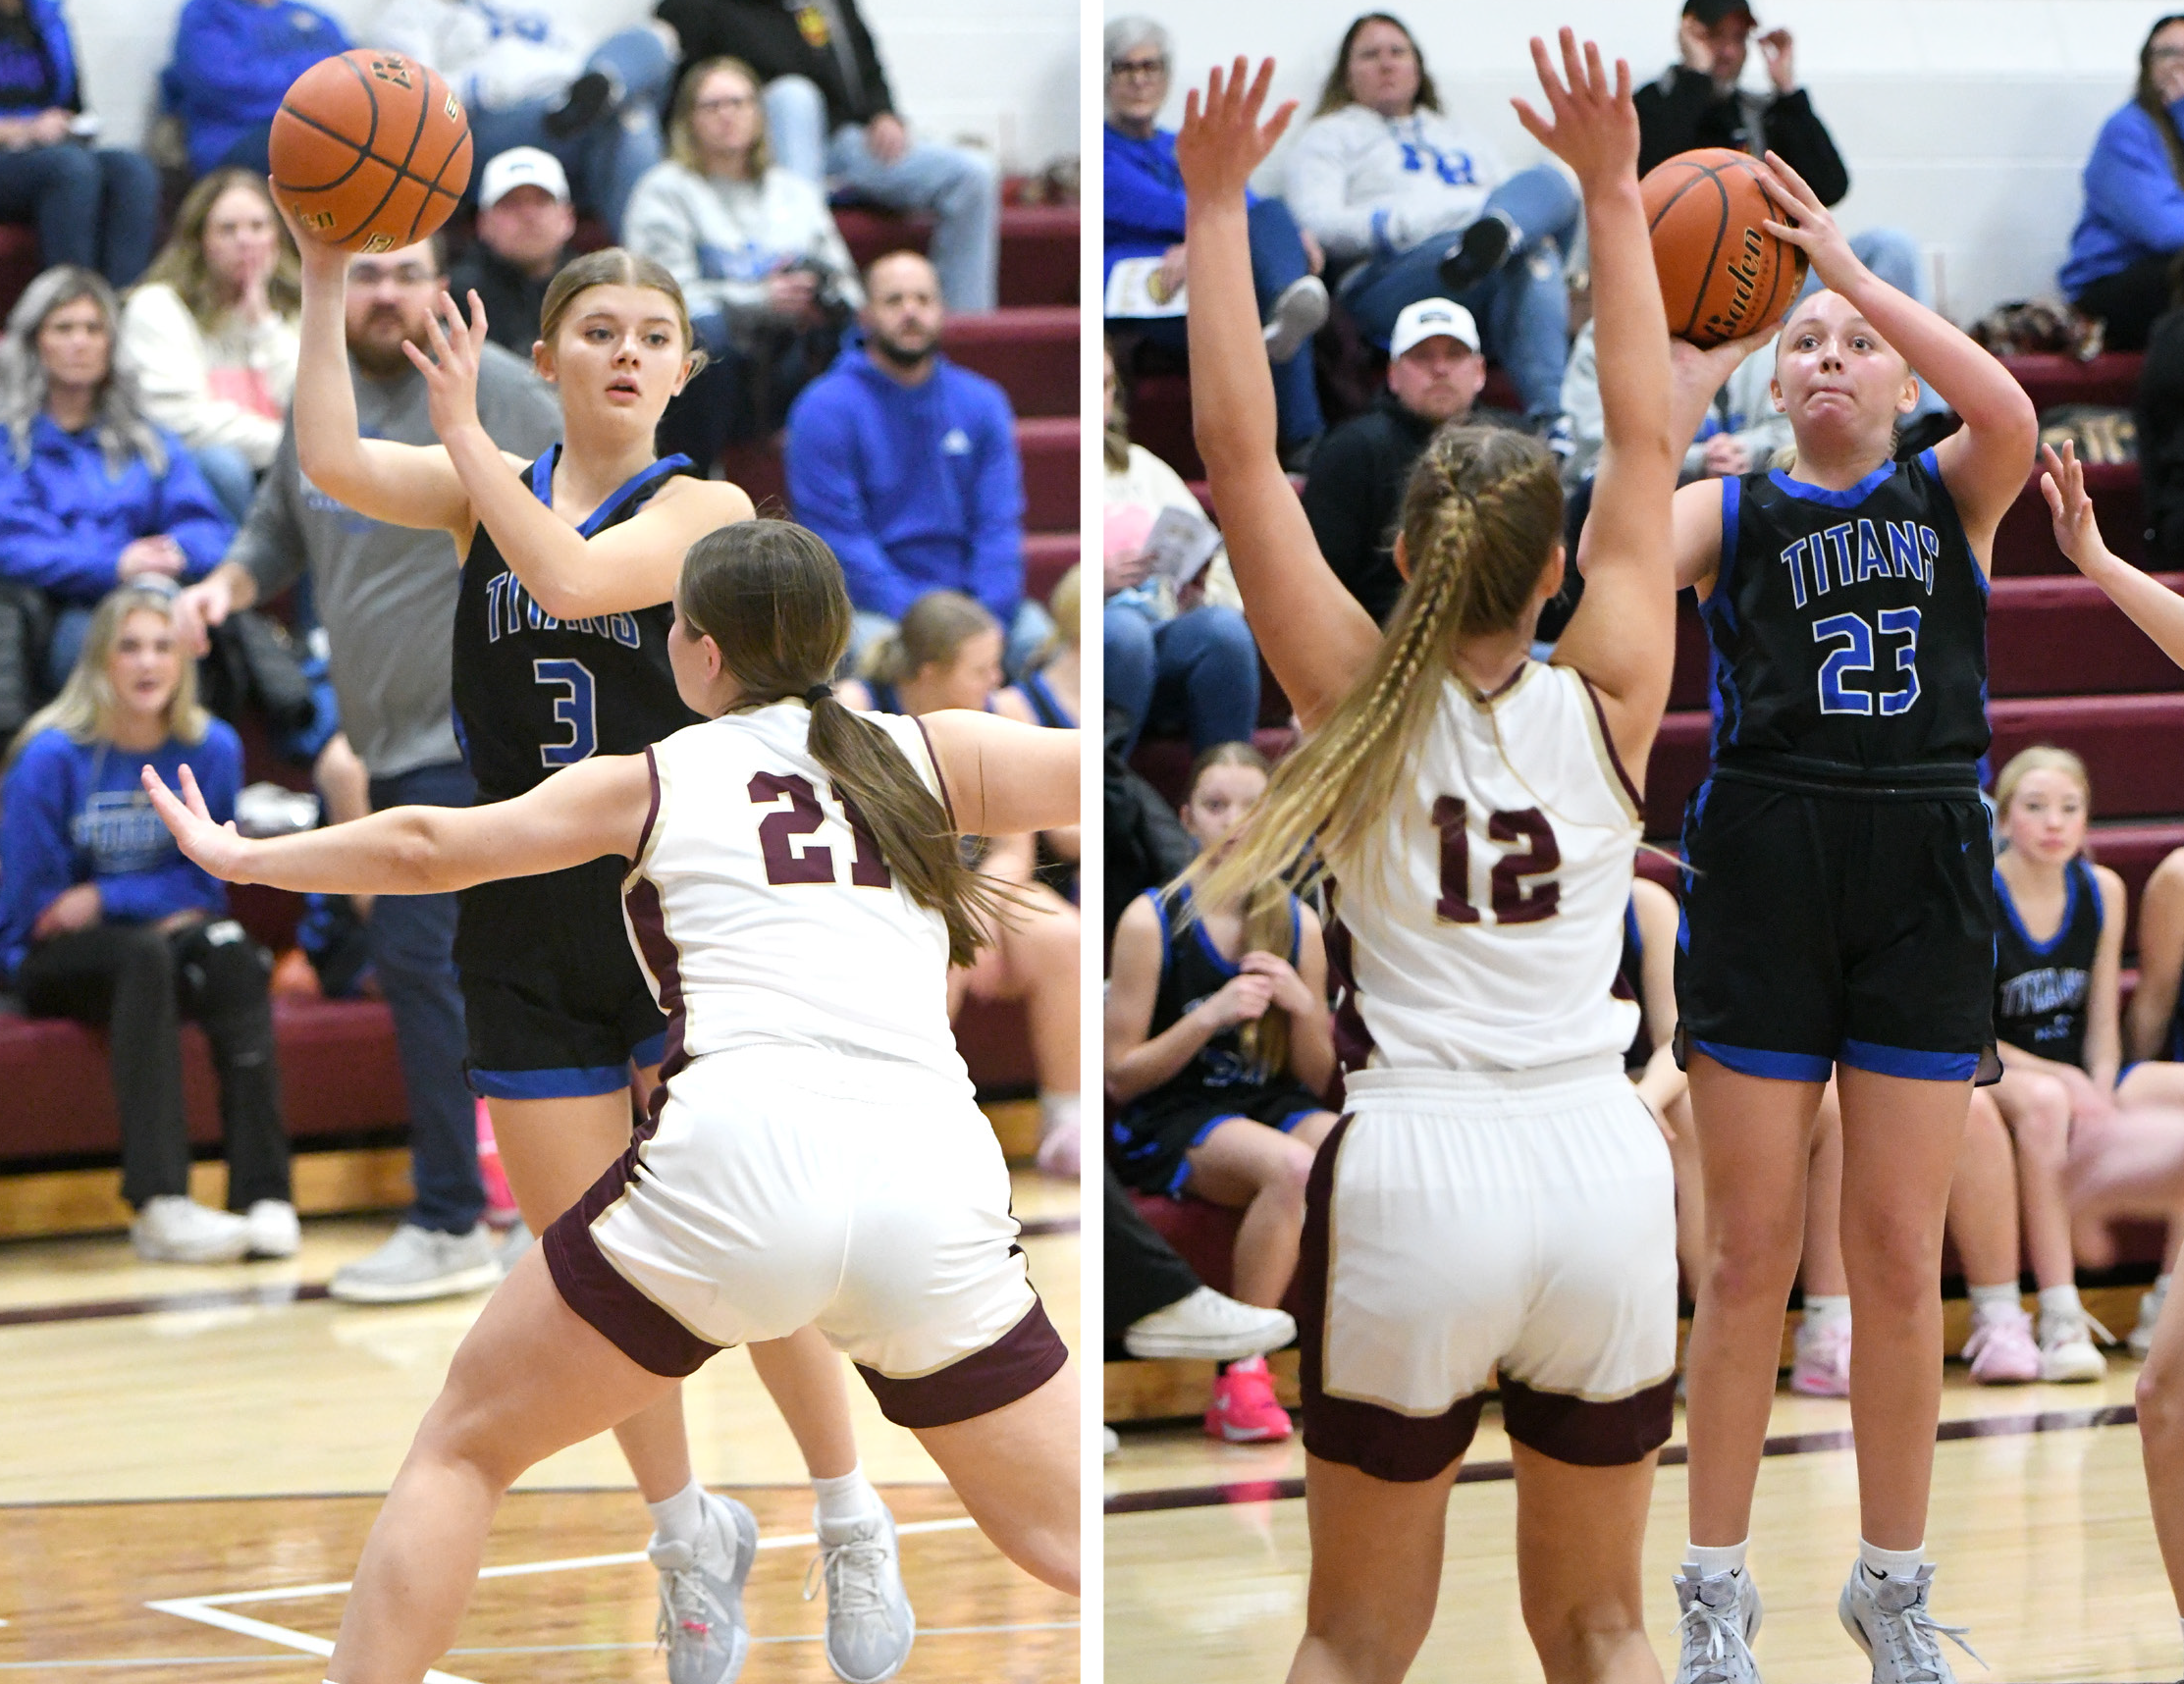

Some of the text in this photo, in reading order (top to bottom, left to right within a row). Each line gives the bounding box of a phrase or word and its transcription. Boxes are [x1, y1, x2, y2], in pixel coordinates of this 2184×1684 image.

[1704, 227, 1764, 341] Baden
[1781, 518, 1940, 609] TITANS
[533, 658, 598, 768] 3
[1812, 605, 1922, 716] 23
[746, 770, 894, 891] 21
[1431, 793, 1563, 925] 12
